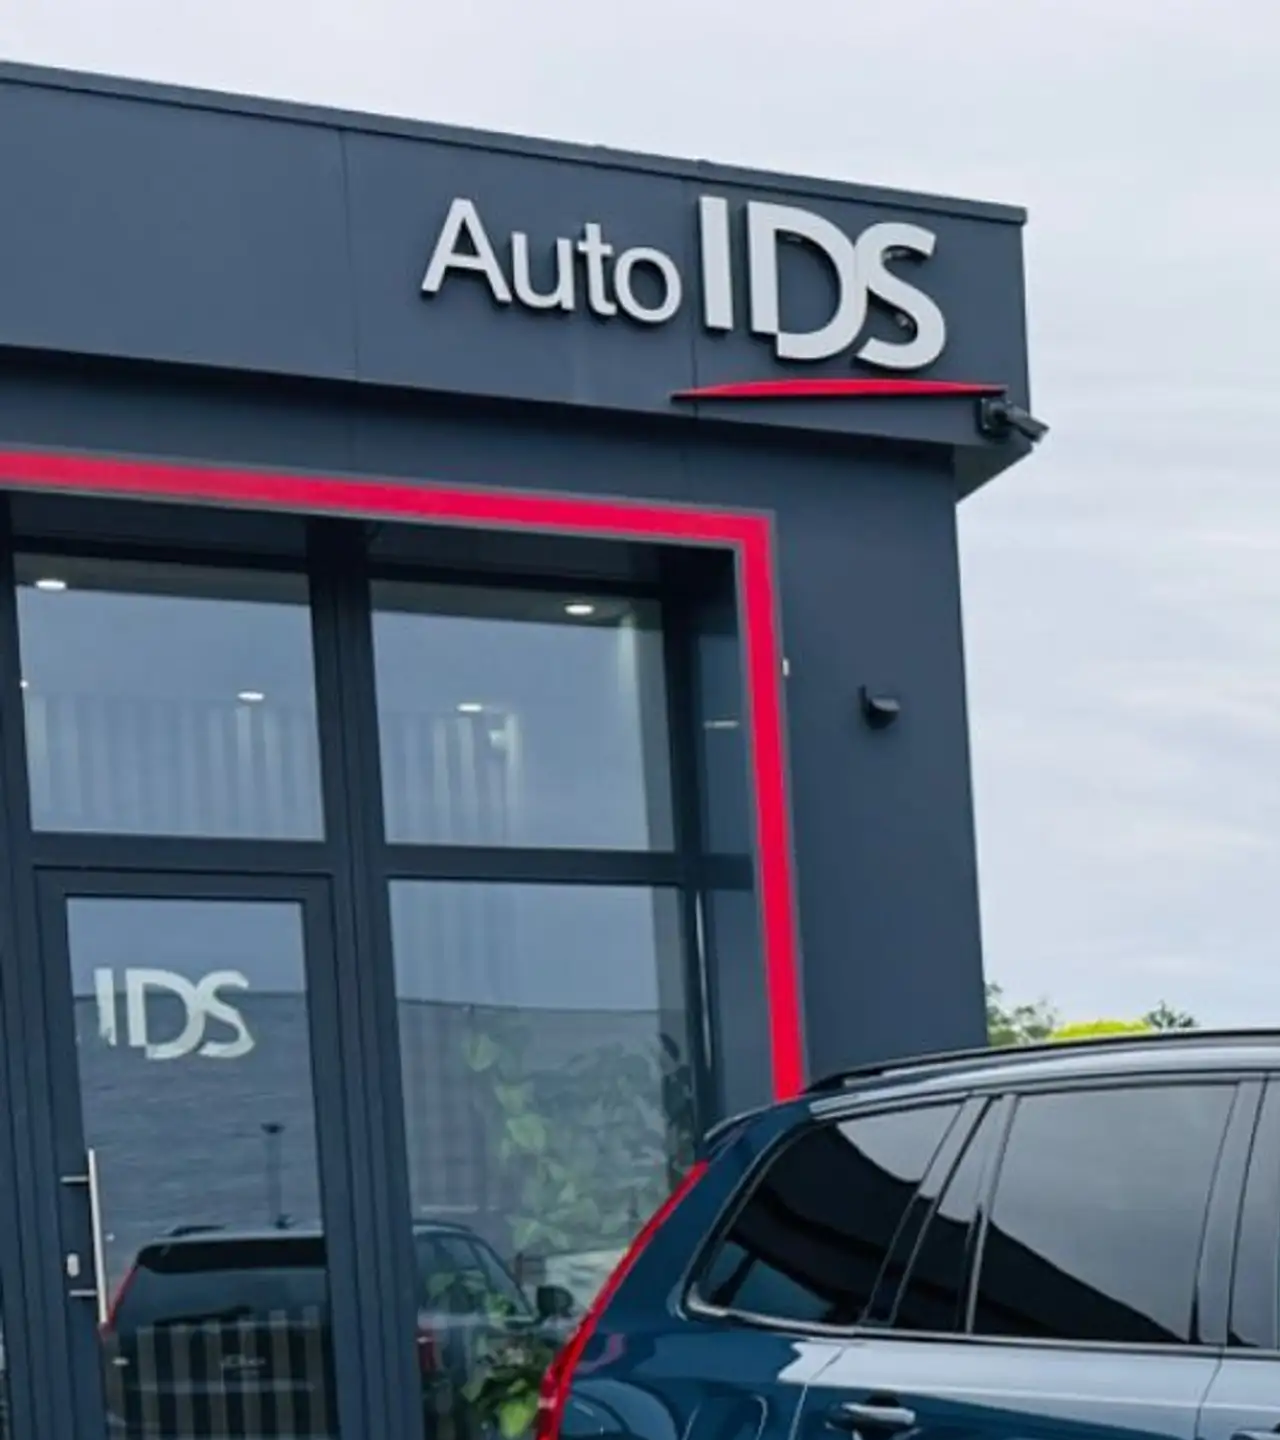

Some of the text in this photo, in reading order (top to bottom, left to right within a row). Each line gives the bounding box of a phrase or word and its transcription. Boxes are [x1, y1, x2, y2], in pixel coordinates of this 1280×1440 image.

[420, 196, 946, 370] Auto IDS
[93, 967, 256, 1060] IDS
